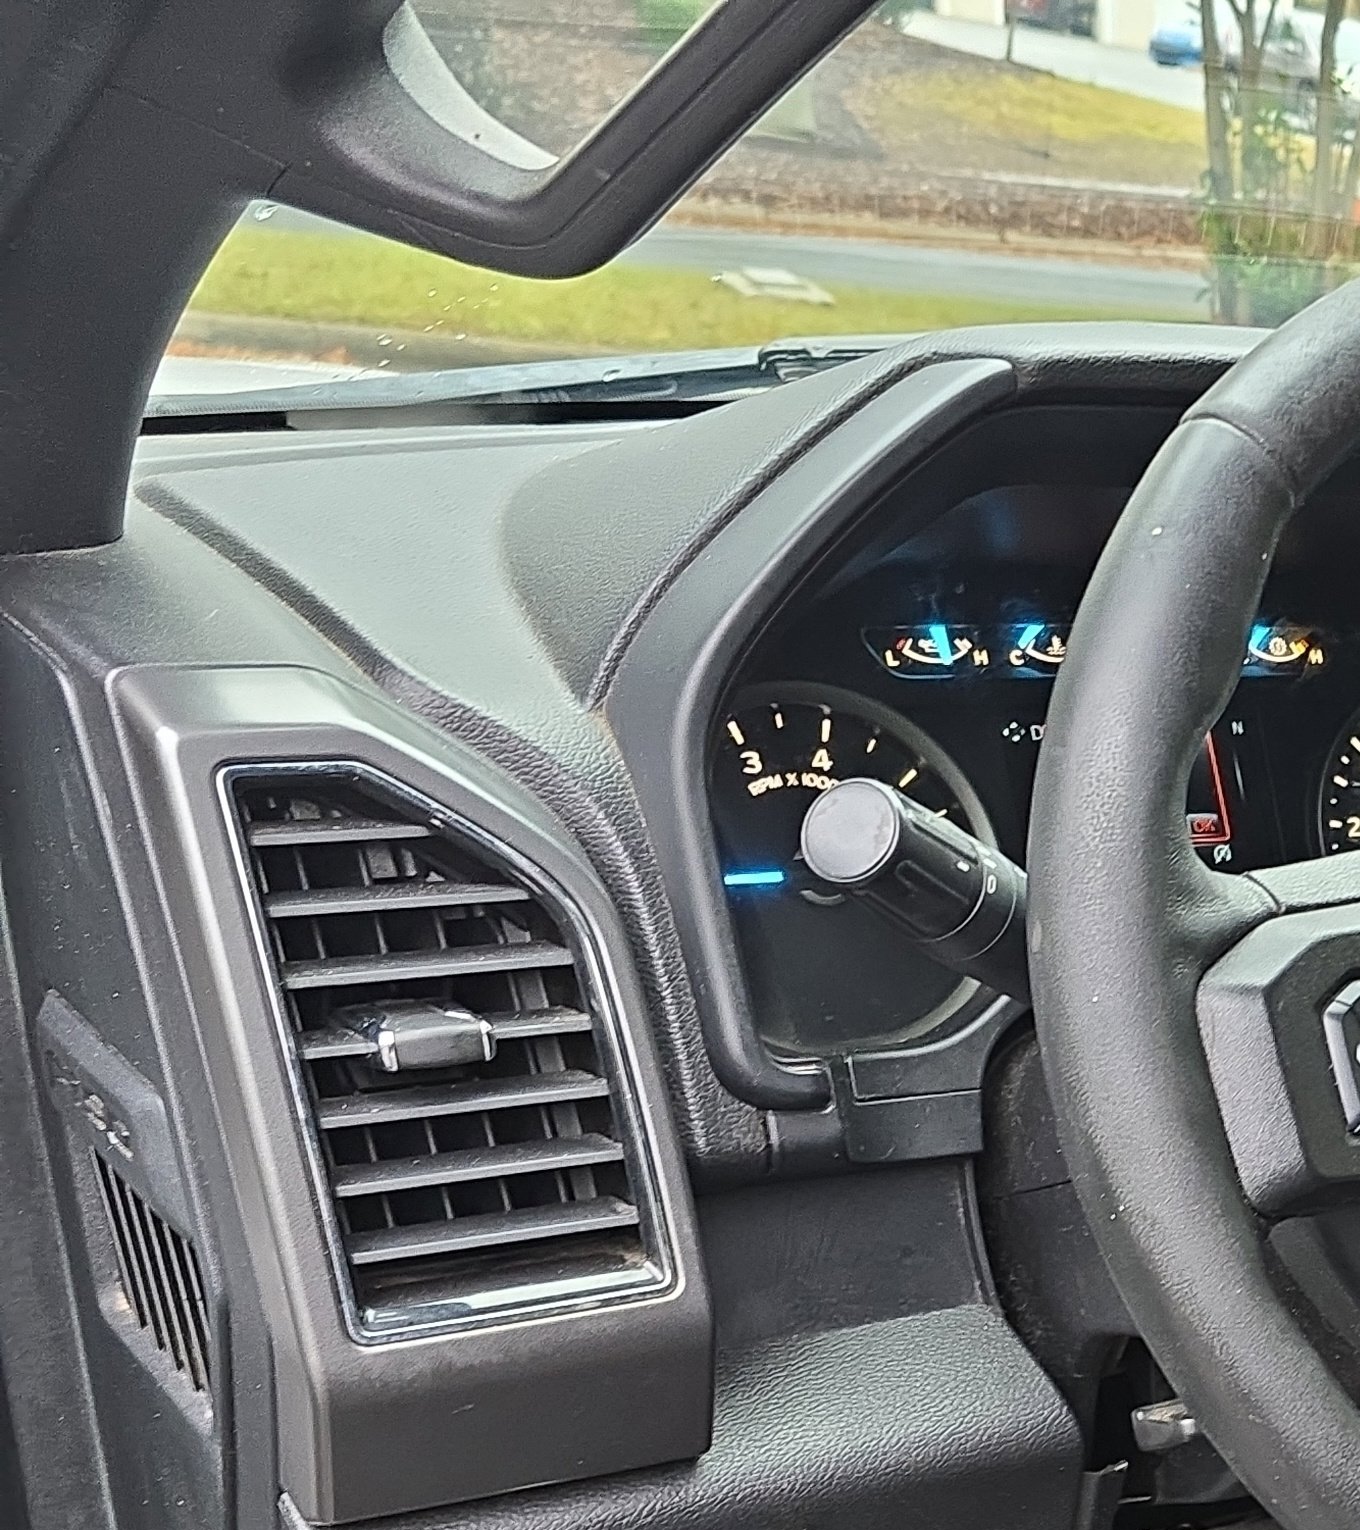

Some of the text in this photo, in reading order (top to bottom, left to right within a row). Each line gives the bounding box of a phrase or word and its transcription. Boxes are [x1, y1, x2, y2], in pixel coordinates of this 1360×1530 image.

[885, 650, 900, 667] L
[973, 649, 990, 665] H
[1009, 650, 1024, 666] C
[1308, 648, 1324, 665] H
[739, 750, 763, 774] 3
[811, 748, 834, 772] 4
[747, 776, 782, 797] RPM
[784, 772, 800, 788] X
